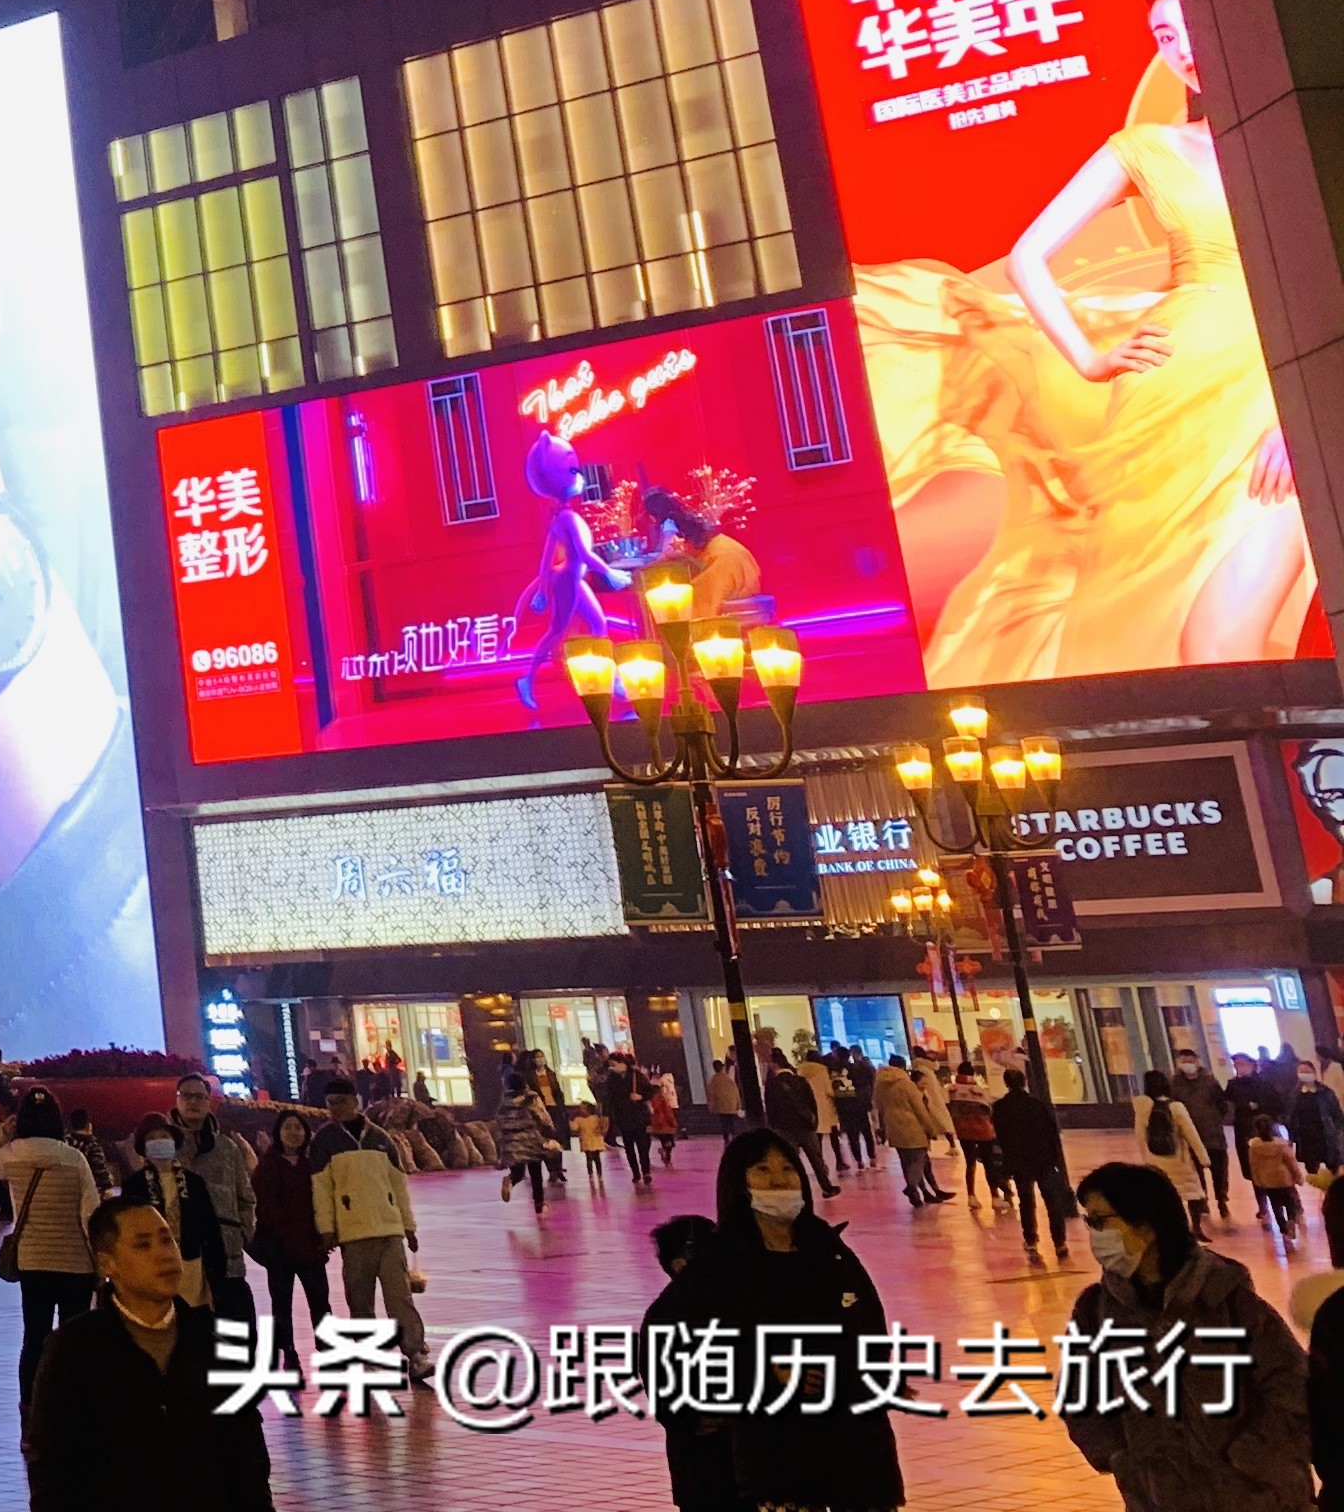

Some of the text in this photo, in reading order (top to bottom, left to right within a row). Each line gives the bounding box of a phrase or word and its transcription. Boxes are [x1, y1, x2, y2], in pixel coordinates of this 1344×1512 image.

[173, 467, 264, 528] 华美
[178, 527, 269, 583] 整形
[212, 641, 278, 670] 96086
[1012, 800, 1222, 836] STARBUCKS
[1055, 831, 1189, 862] COFFEE
[333, 848, 468, 900] 周六福
[816, 858, 918, 876] BANK OF CHINA
